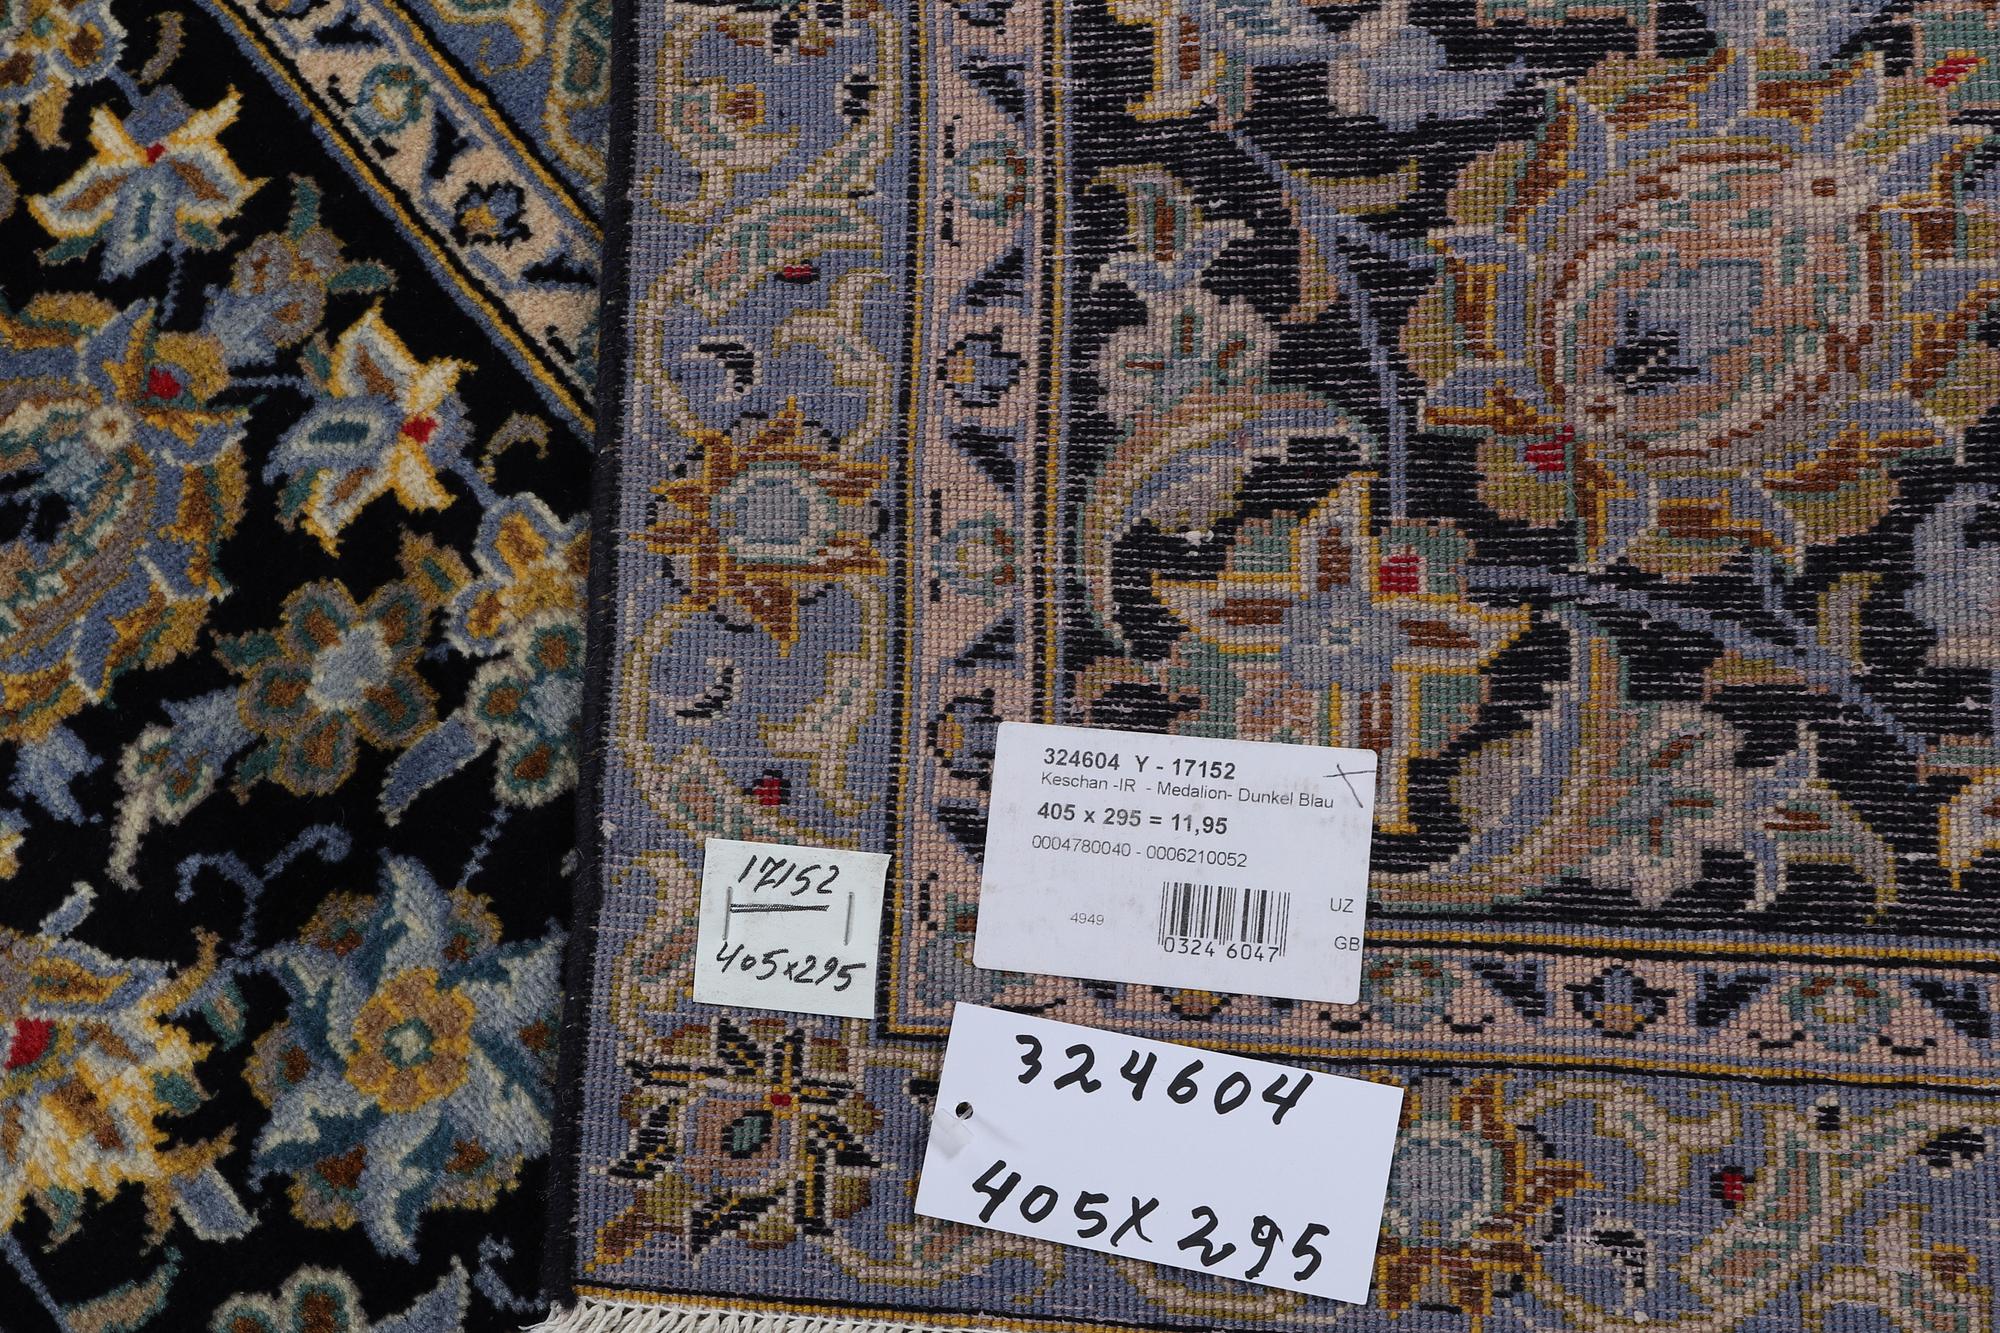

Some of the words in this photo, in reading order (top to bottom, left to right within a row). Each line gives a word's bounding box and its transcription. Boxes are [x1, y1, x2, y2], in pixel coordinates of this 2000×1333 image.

[1043, 747, 1120, 771] 324604
[1134, 754, 1150, 773] Y
[1172, 758, 1236, 781] 17152
[1041, 772, 1108, 790] Keschan
[1238, 787, 1294, 805] Dunkel
[1298, 792, 1334, 809] Blau
[1037, 801, 1076, 821] 405
[1083, 809, 1096, 824] x
[1102, 807, 1142, 827] 295
[1171, 813, 1228, 836] 11,95
[1031, 834, 1132, 857] 0004780040
[1146, 844, 1248, 868] 0006210052
[737, 855, 840, 896] 17152
[1070, 912, 1105, 926] 4949
[1330, 897, 1354, 914] UZ
[1163, 936, 1215, 957] 0324
[1226, 943, 1279, 962] 6047
[1334, 935, 1360, 952] GB
[1015, 1034, 1314, 1125] 324604
